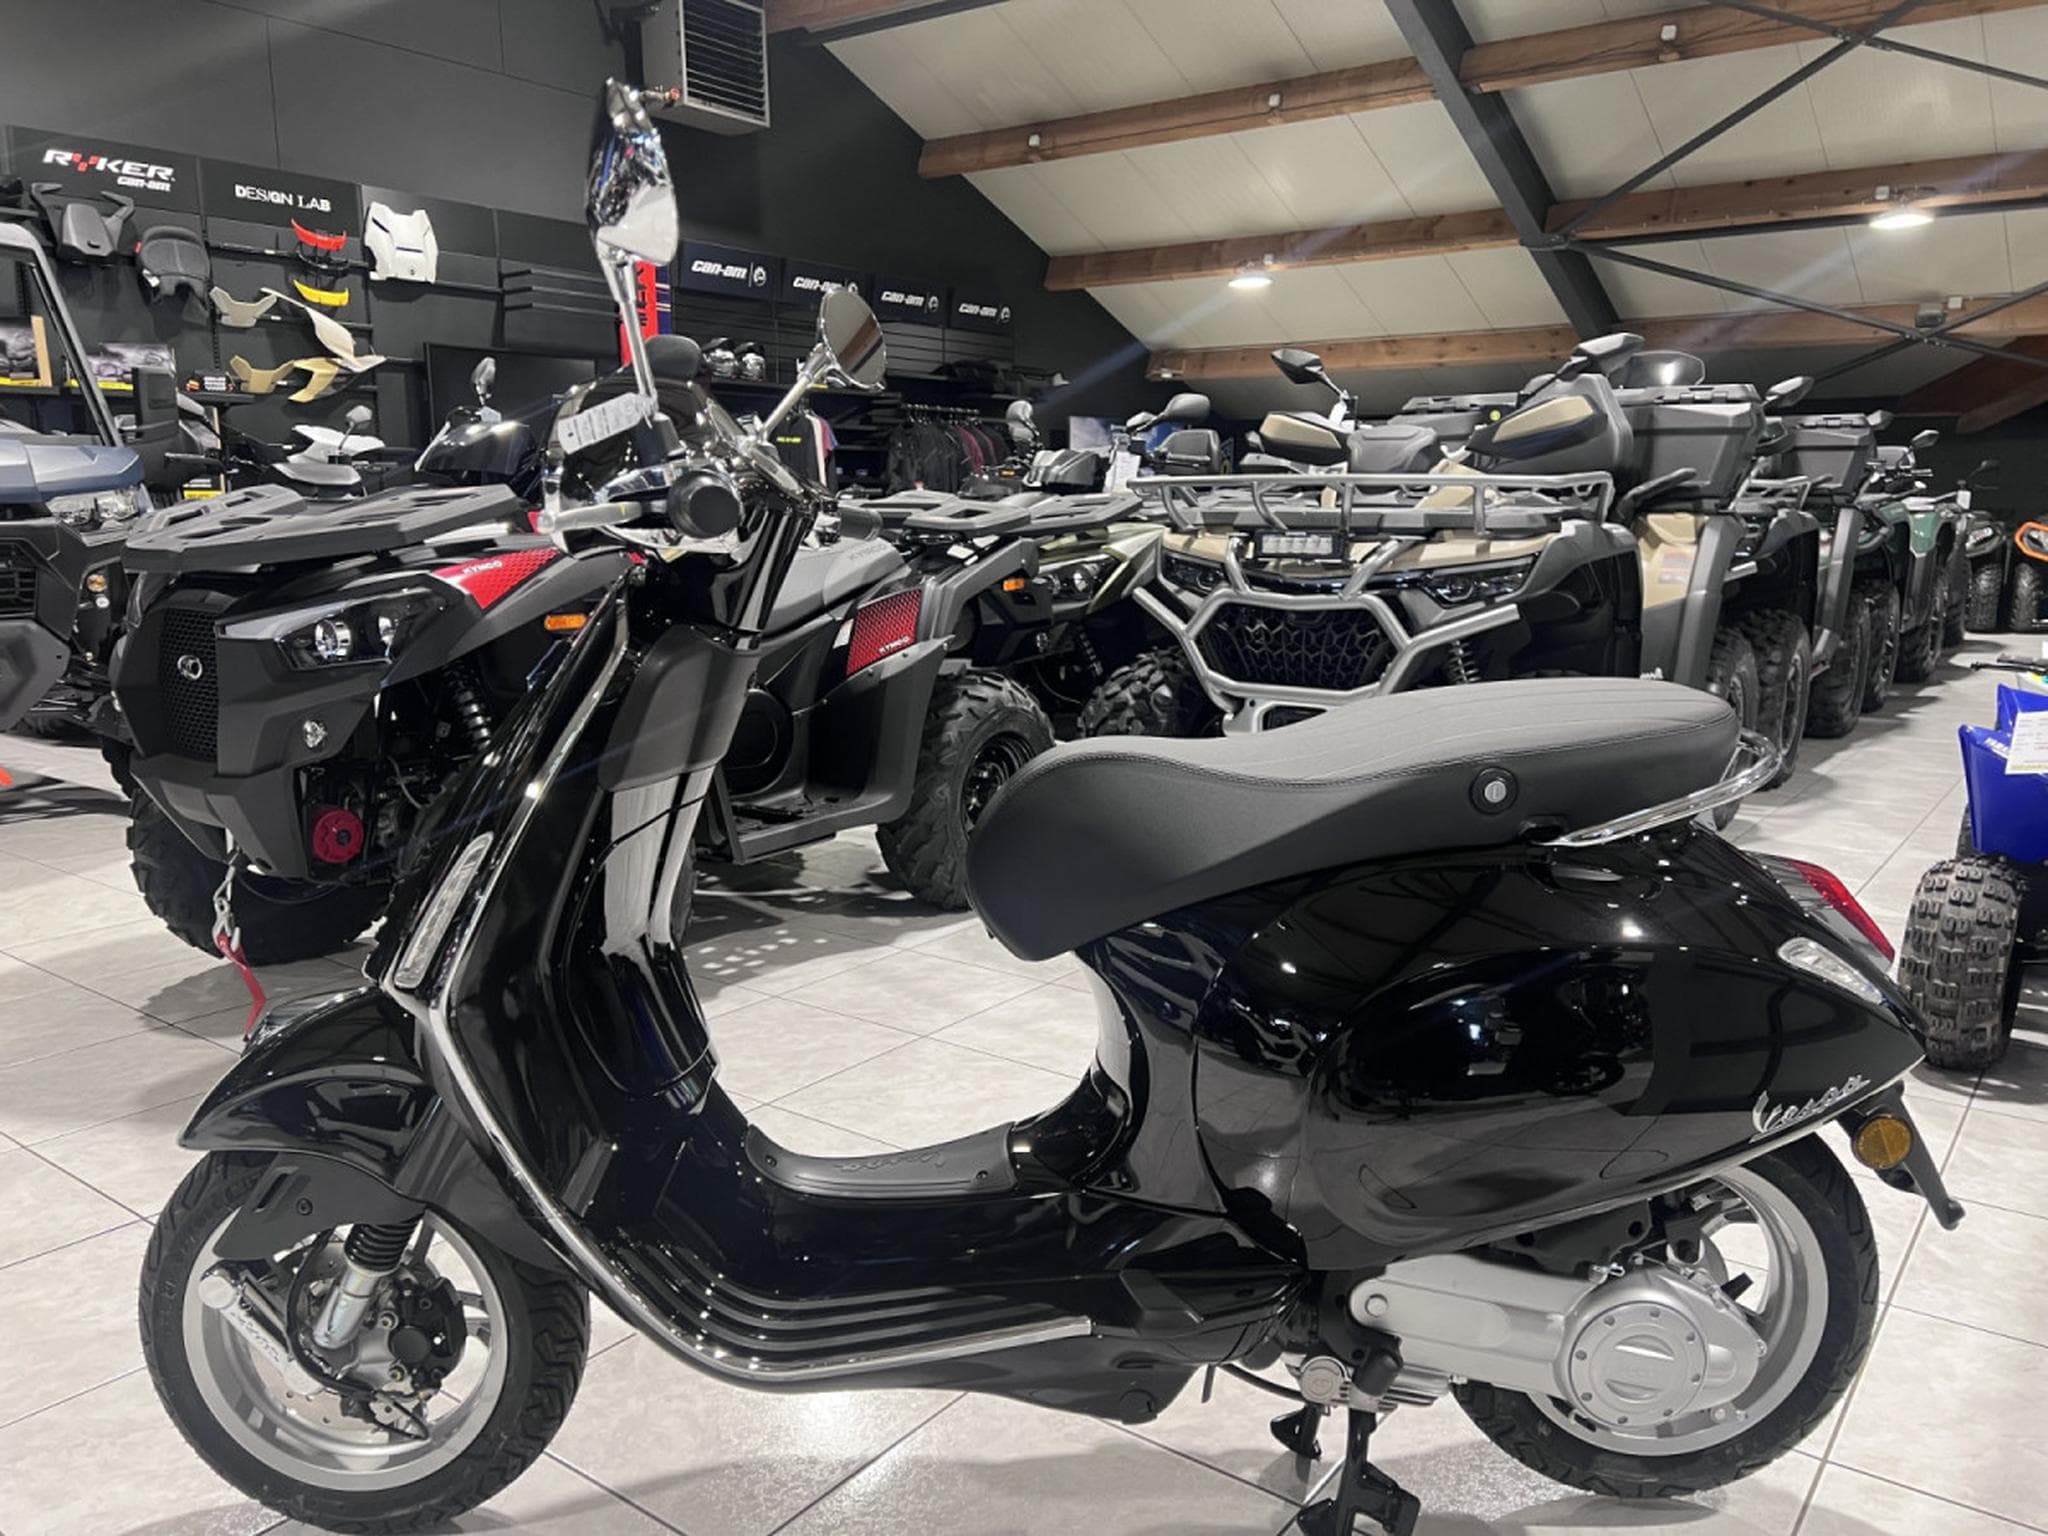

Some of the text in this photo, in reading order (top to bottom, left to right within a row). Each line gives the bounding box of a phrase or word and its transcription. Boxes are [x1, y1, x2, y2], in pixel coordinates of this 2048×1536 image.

[43, 149, 174, 181] RYKER
[235, 184, 331, 212] DESIGN LAB
[691, 260, 747, 280] can-am
[881, 291, 924, 307] can-am
[958, 303, 997, 318] can-am
